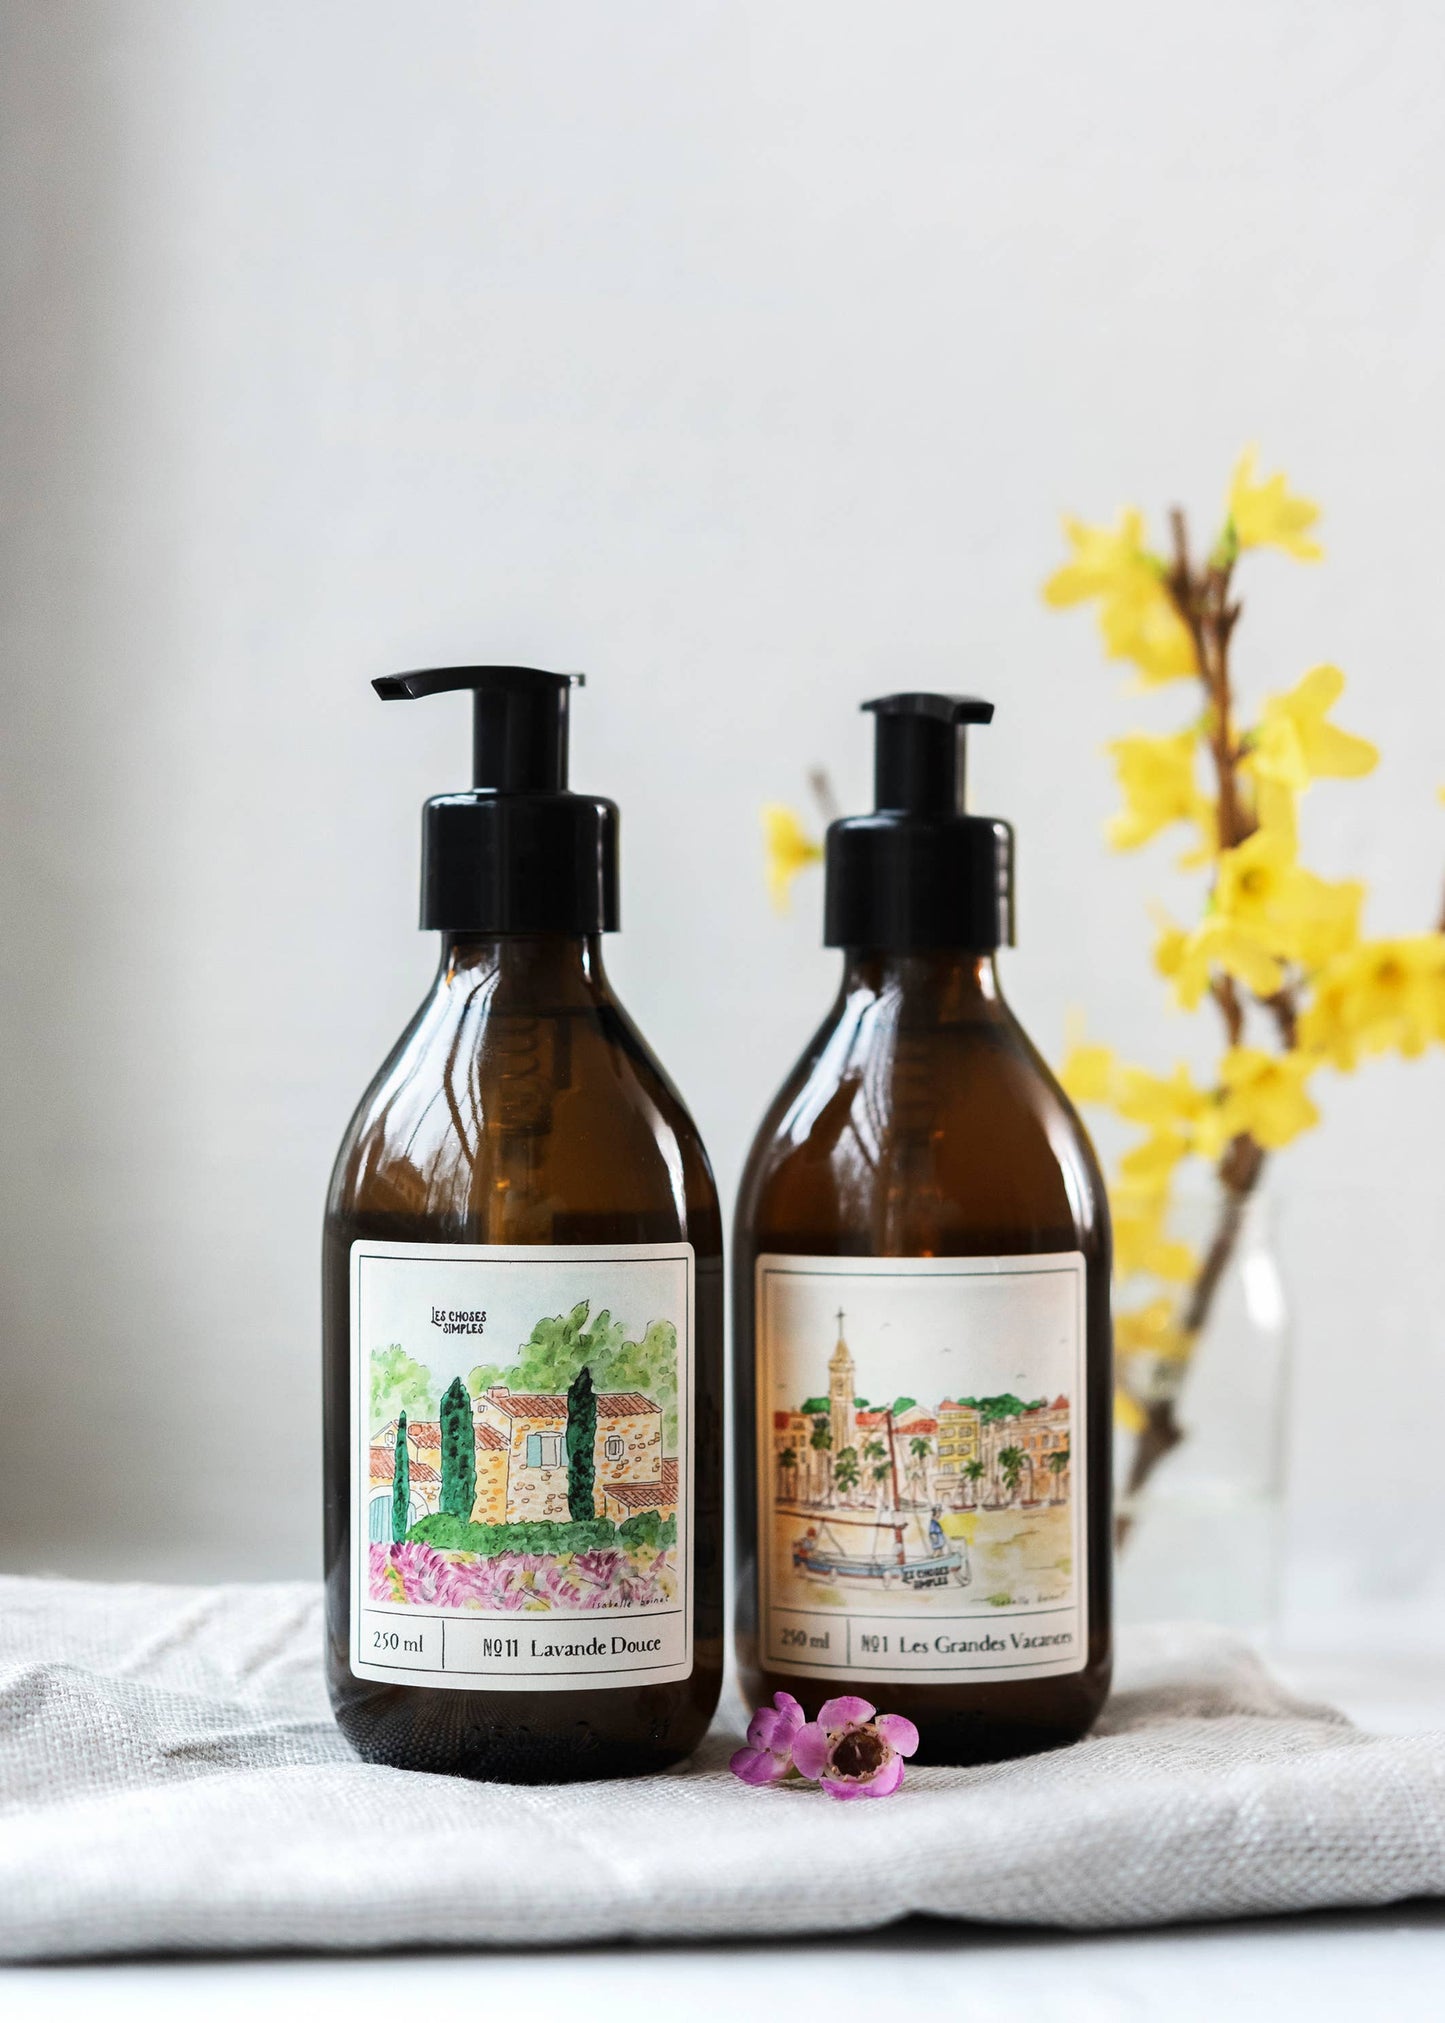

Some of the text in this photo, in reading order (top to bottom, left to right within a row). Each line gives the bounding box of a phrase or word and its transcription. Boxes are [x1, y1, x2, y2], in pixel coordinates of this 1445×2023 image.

[431, 1306, 487, 1327] LES CHOSES
[442, 1323, 484, 1334] SIMPLES
[373, 1631, 424, 1653] 250 ml
[530, 1636, 607, 1658] Lavande
[611, 1635, 661, 1655] Douce
[781, 1628, 830, 1649] 250 ml
[900, 1636, 929, 1653] Les
[935, 1632, 1006, 1653] Grandes
[1010, 1629, 1073, 1649] Vacances
